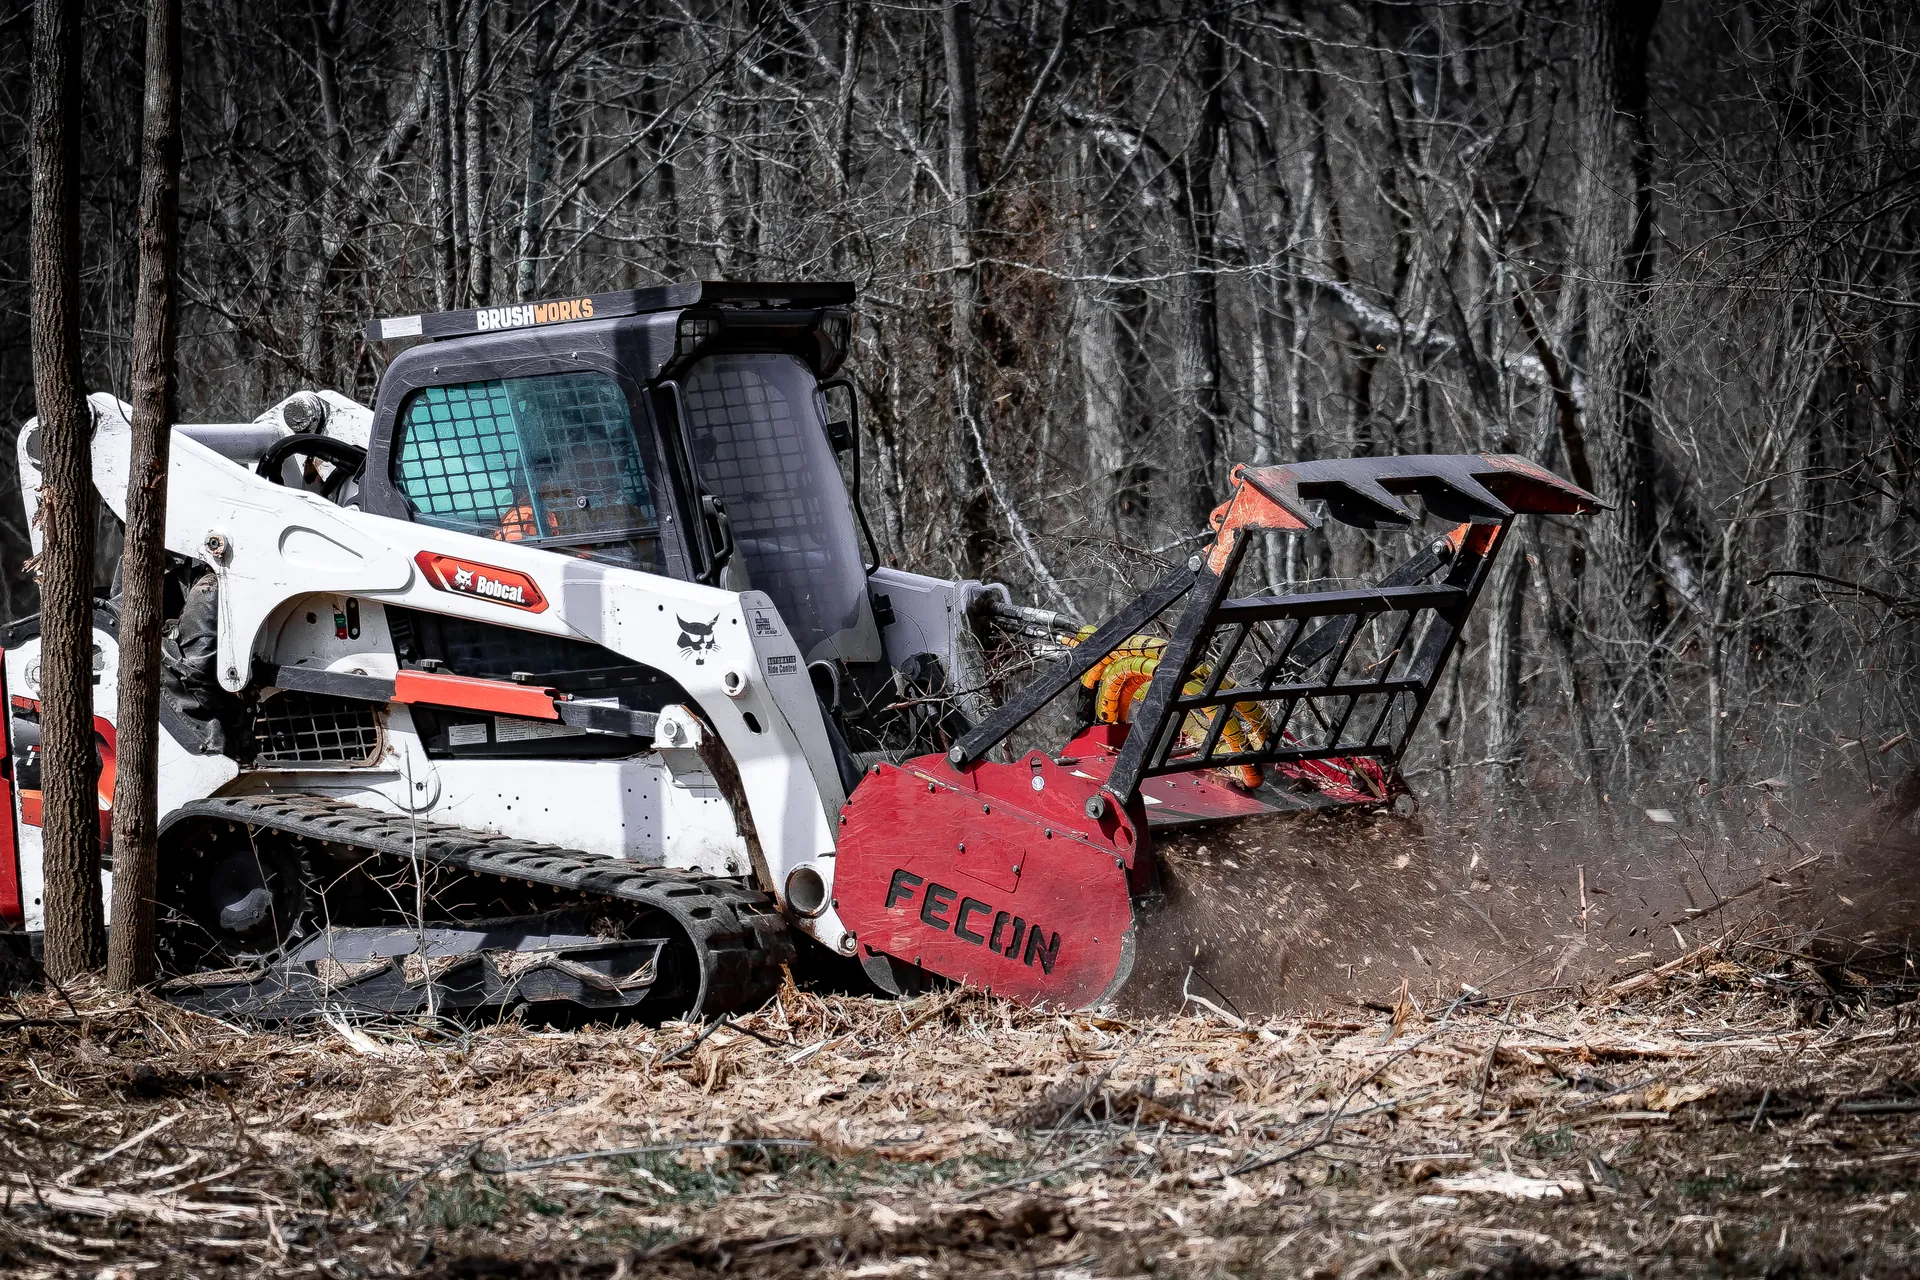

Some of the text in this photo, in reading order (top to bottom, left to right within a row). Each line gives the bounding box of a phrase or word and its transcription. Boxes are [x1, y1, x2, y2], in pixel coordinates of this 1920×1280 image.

[477, 299, 593, 330] BRUSHWORKS
[767, 656, 796, 664] AUTOMATIC
[767, 664, 797, 674] Ride Control
[885, 868, 1060, 975] FECON
